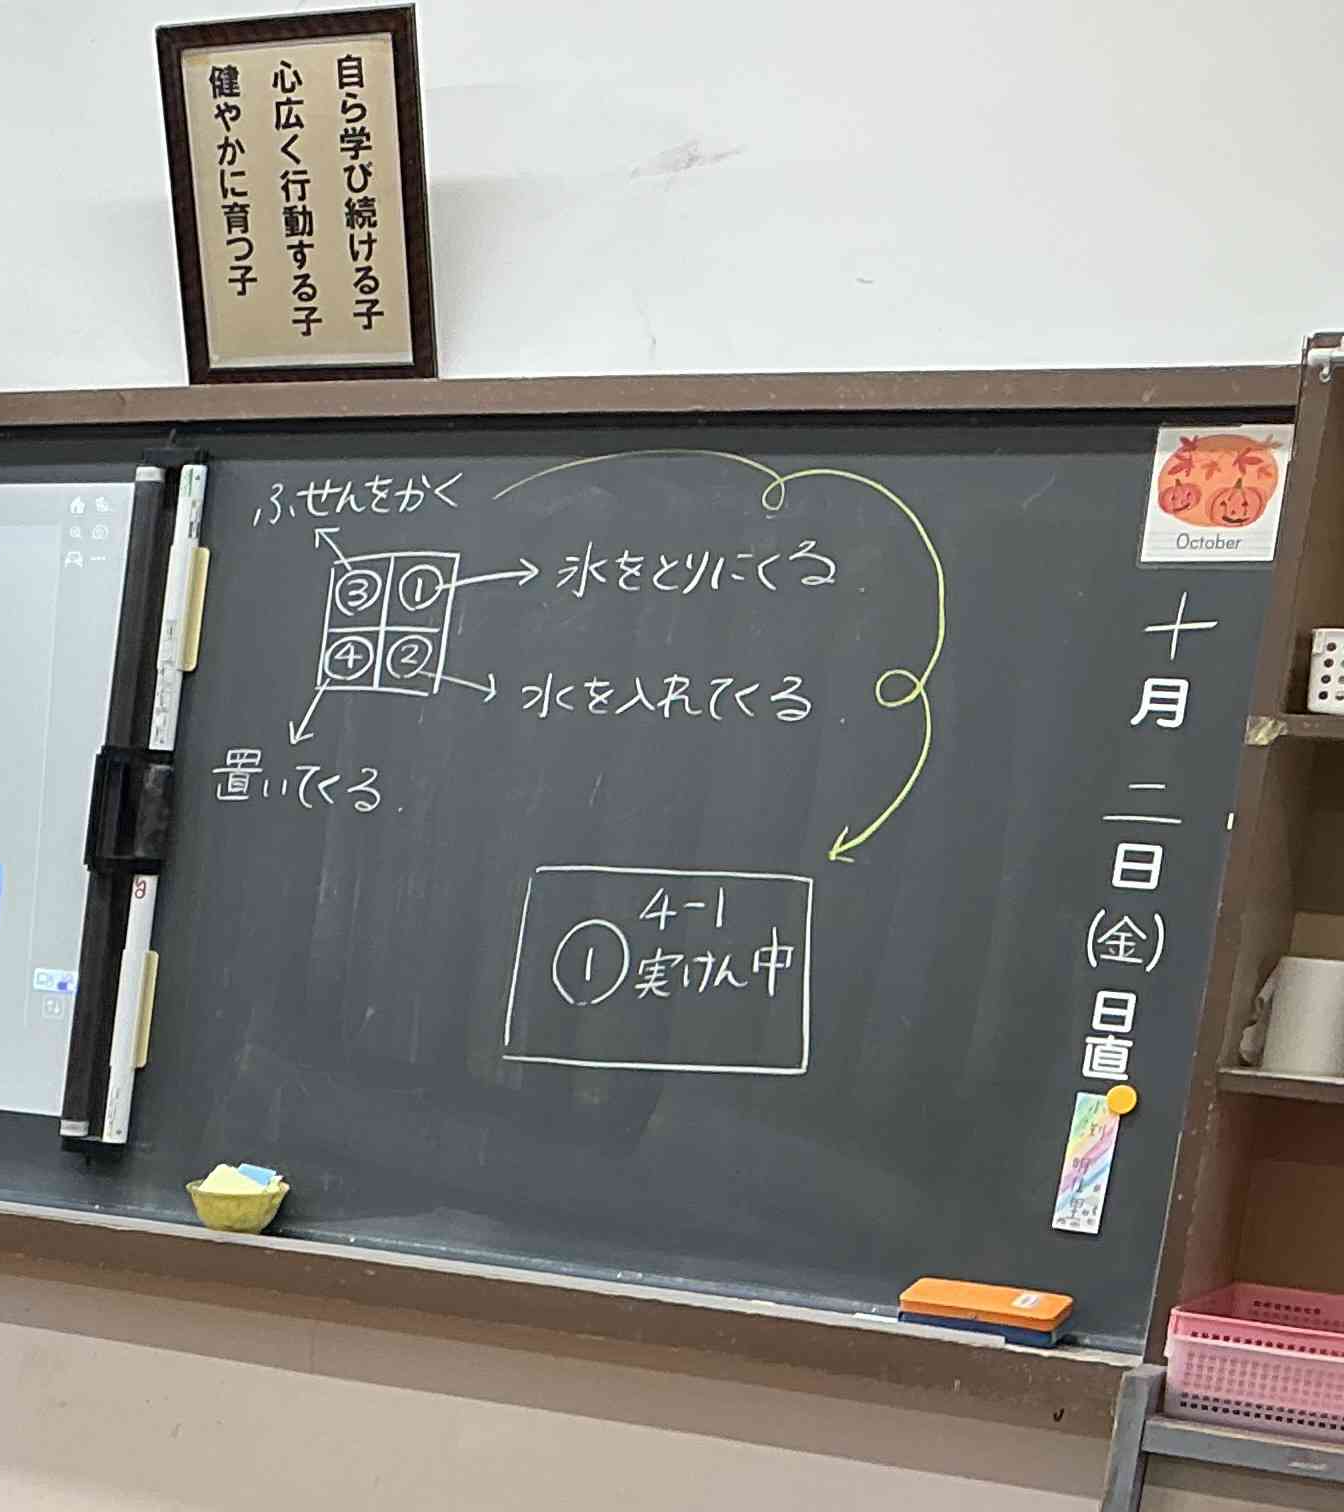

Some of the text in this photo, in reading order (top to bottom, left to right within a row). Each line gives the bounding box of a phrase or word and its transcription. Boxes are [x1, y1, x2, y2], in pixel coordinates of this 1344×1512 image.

[209, 64, 258, 297] 健やかに育つ子
[271, 60, 322, 337] 心広く行動する子
[336, 54, 384, 330] 自ら学び続ける子
[252, 472, 463, 528] ふせんをかく
[1175, 533, 1244, 552] October
[521, 672, 813, 722] 水を入れてくる
[212, 748, 382, 812] 置いてくる
[640, 886, 726, 931] 4-1
